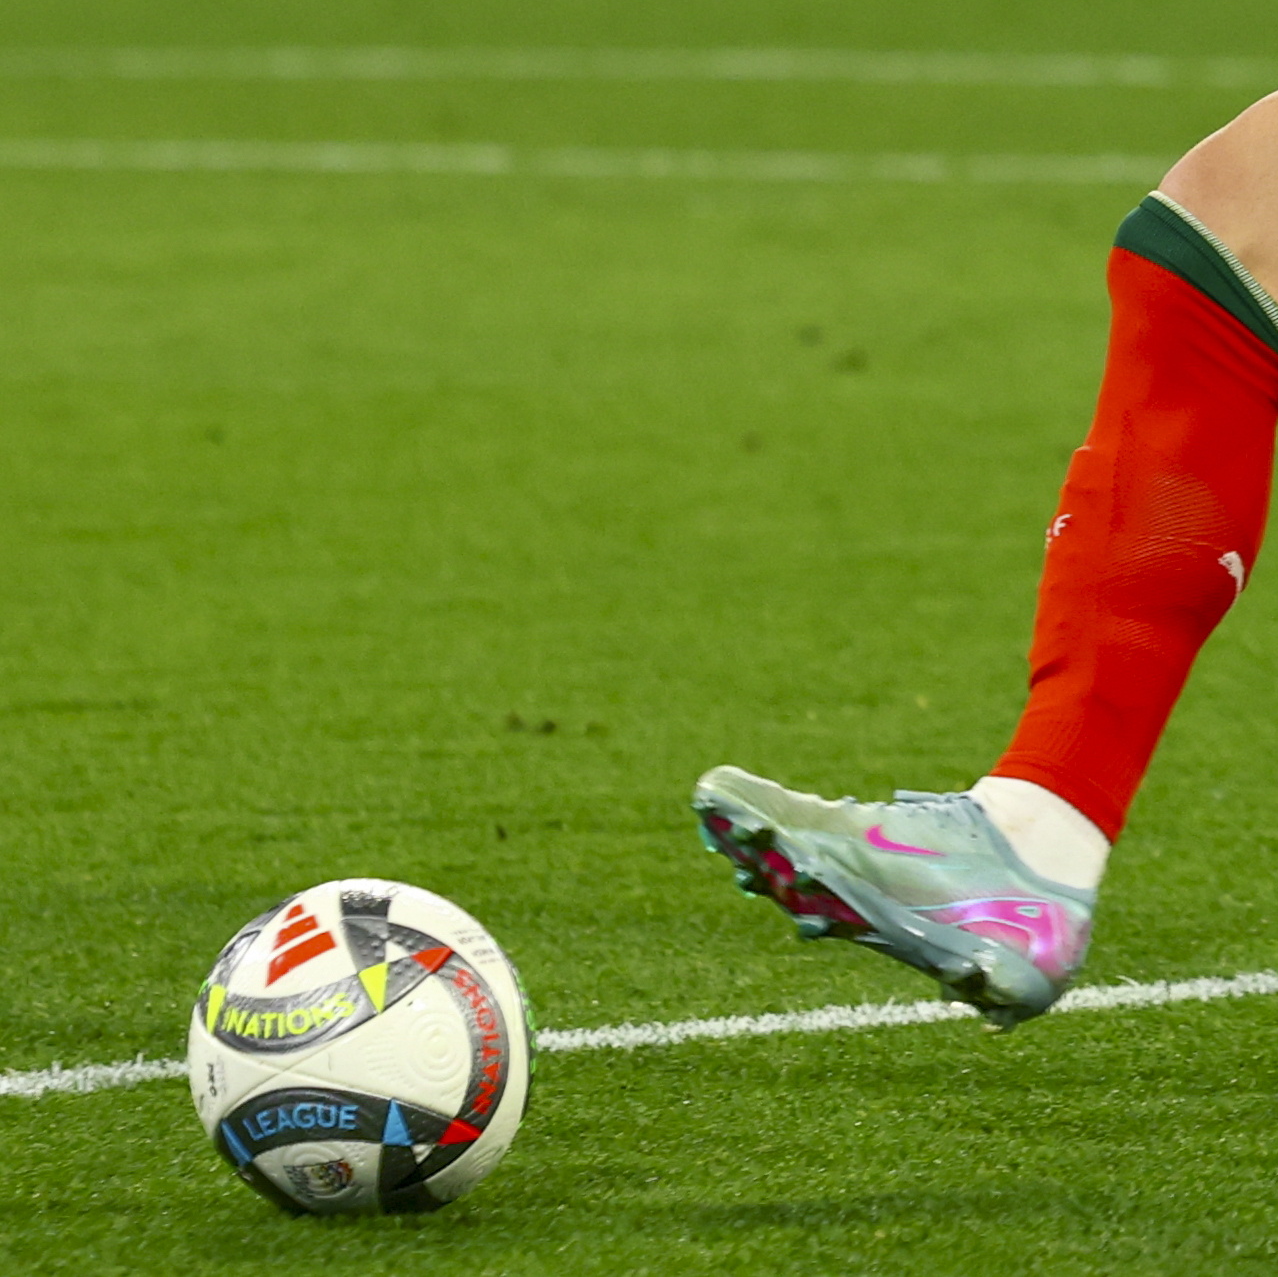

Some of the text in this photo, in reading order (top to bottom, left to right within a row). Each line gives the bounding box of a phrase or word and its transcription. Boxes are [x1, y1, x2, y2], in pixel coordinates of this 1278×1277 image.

[222, 992, 356, 1039] NATIONS
[452, 969, 502, 1115] NATIONS
[243, 1102, 359, 1141] LEAGUE
